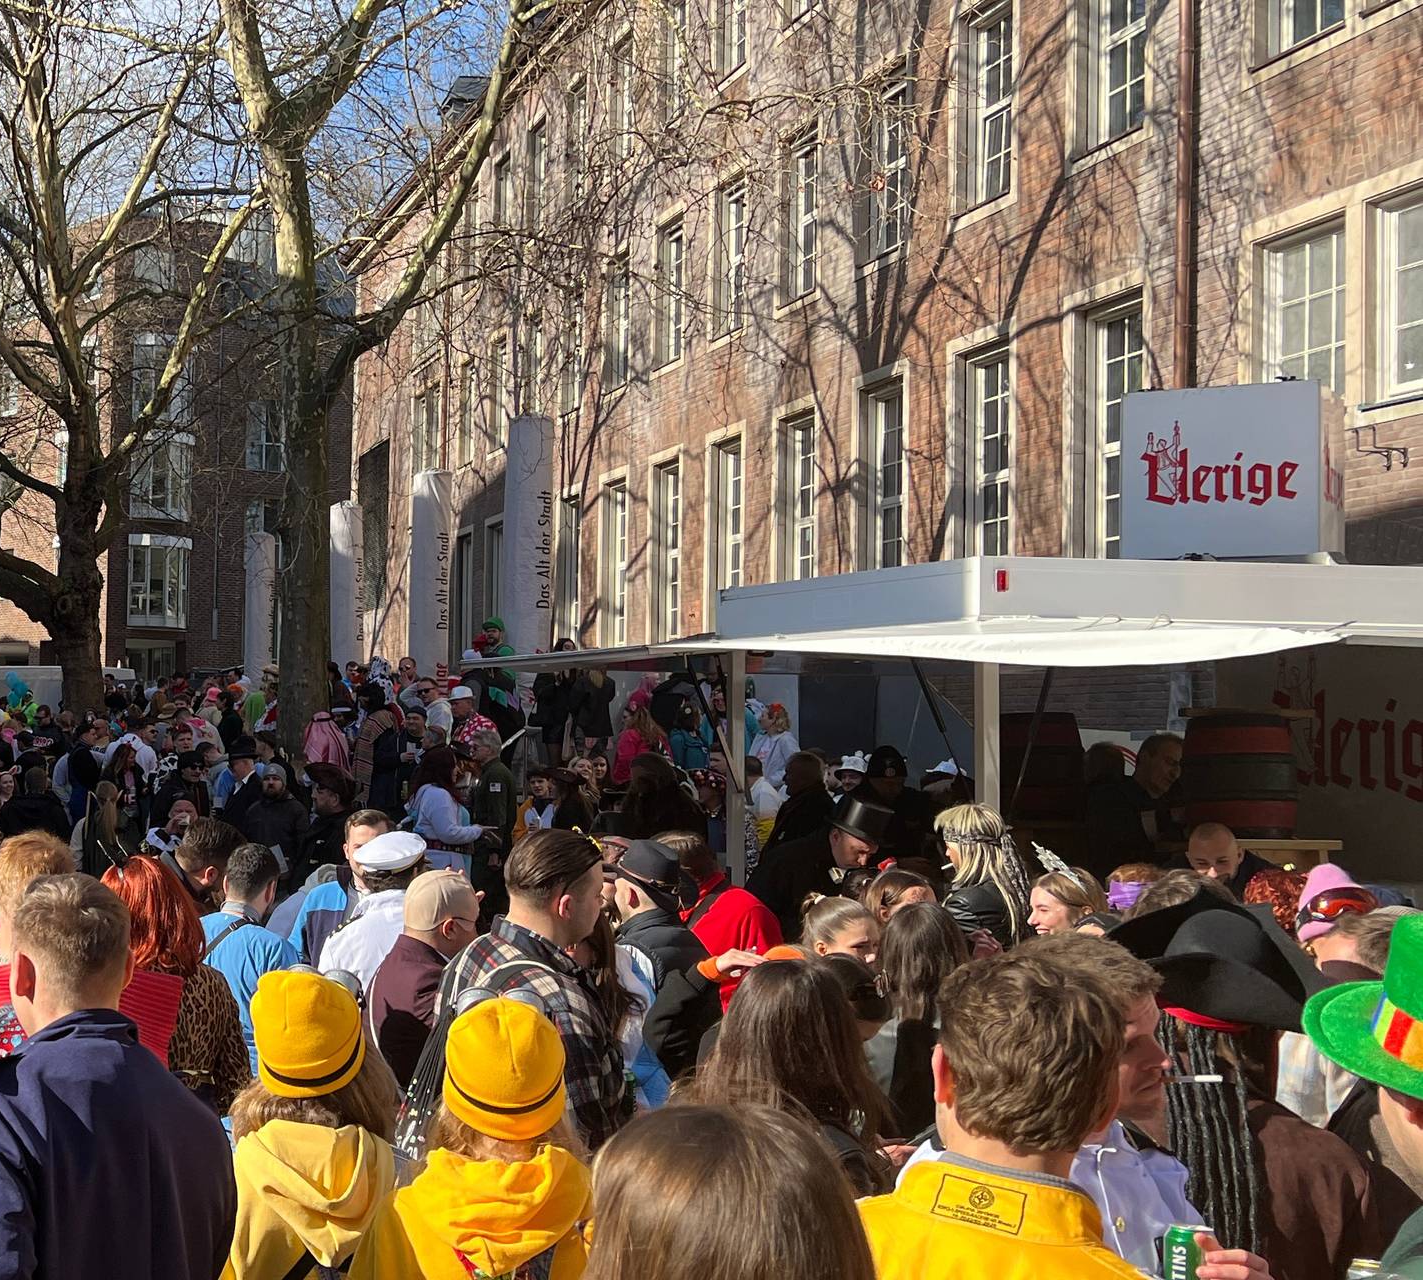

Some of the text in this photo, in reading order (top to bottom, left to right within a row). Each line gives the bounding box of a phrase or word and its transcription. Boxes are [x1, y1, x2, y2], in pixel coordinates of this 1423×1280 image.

[1140, 448, 1299, 506] Uerige
[435, 532, 449, 630] Das Alt der Stadt
[535, 490, 552, 609] Das Alt der Stadt
